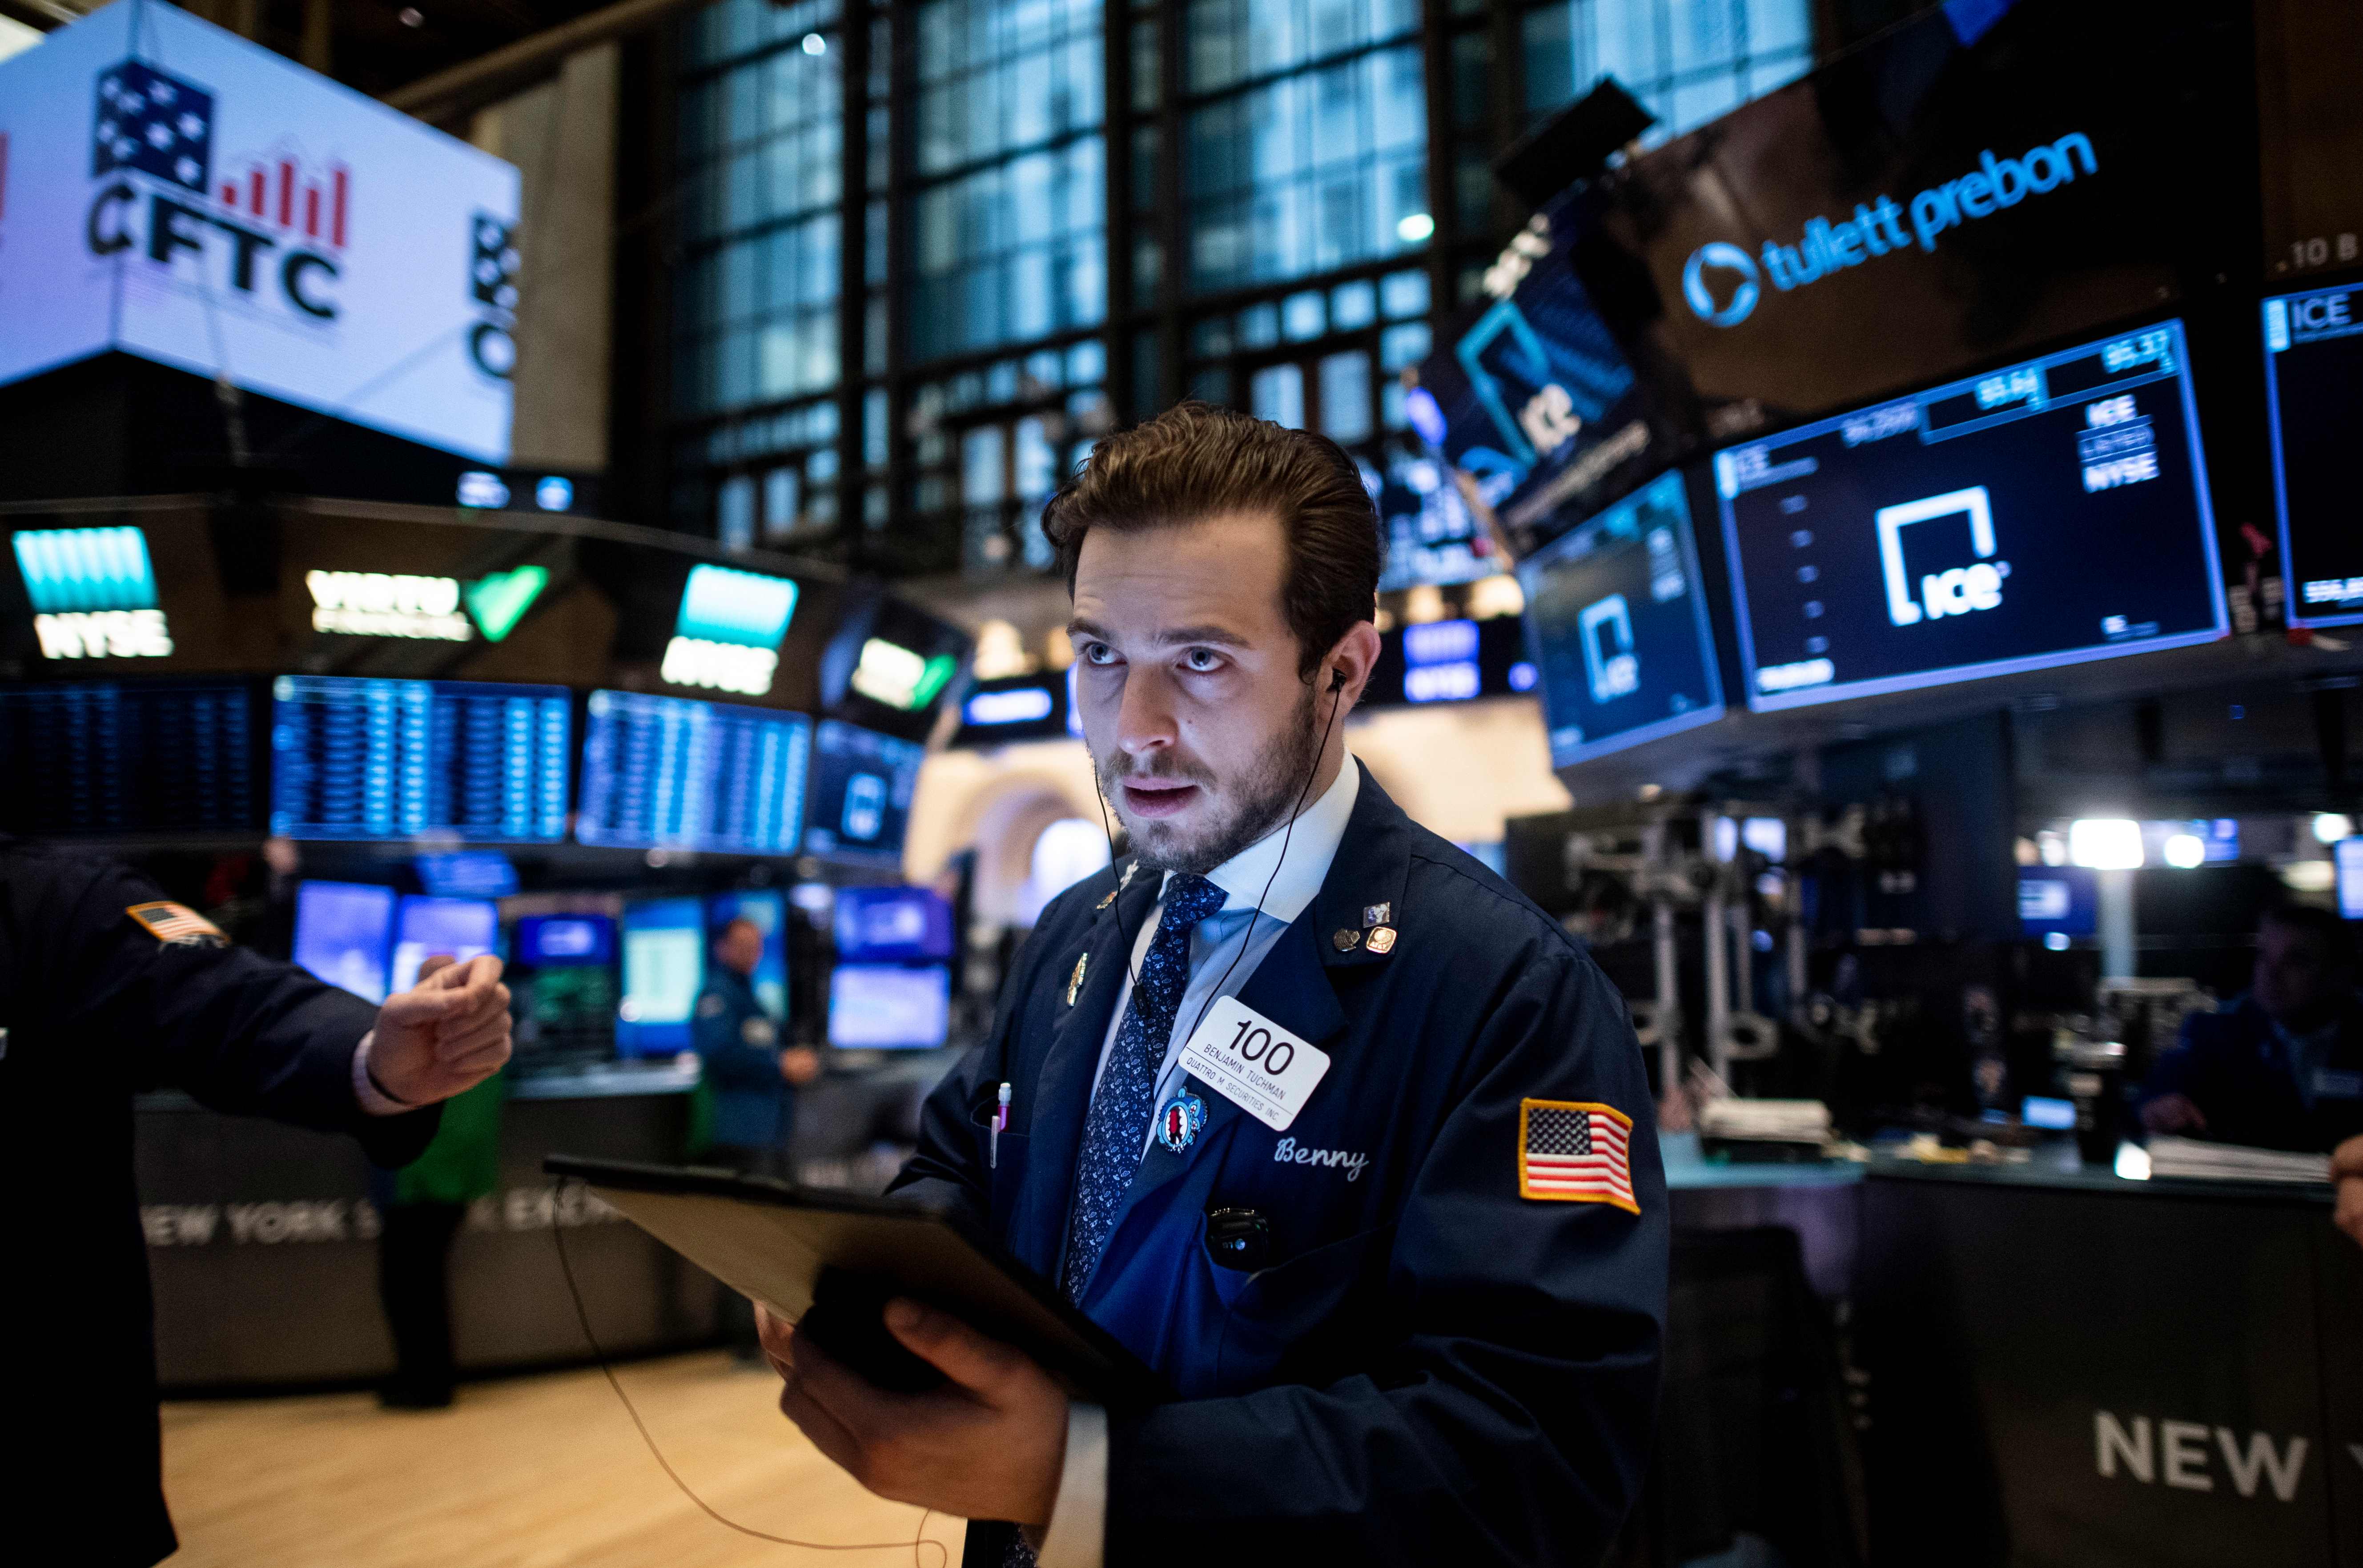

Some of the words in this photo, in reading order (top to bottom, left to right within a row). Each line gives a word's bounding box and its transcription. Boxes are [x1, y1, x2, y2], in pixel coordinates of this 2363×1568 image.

[1762, 194, 1912, 292] tullett
[1910, 132, 2098, 252] prebon
[86, 181, 341, 320] CFTC
[2292, 293, 2352, 328] ICE
[34, 609, 174, 659] NYSE
[1204, 1043, 1245, 1074] BENJAMIN
[1246, 1070, 1286, 1101] TUCHMAN
[1229, 1020, 1295, 1076] 100
[1186, 1057, 1217, 1080] QUATTRO
[1217, 1076, 1225, 1086] M
[1226, 1082, 1265, 1111] SECURITIES
[1265, 1108, 1279, 1122] INC.
[1274, 1136, 1370, 1182] Benny
[2094, 1410, 2310, 1503] NEW
